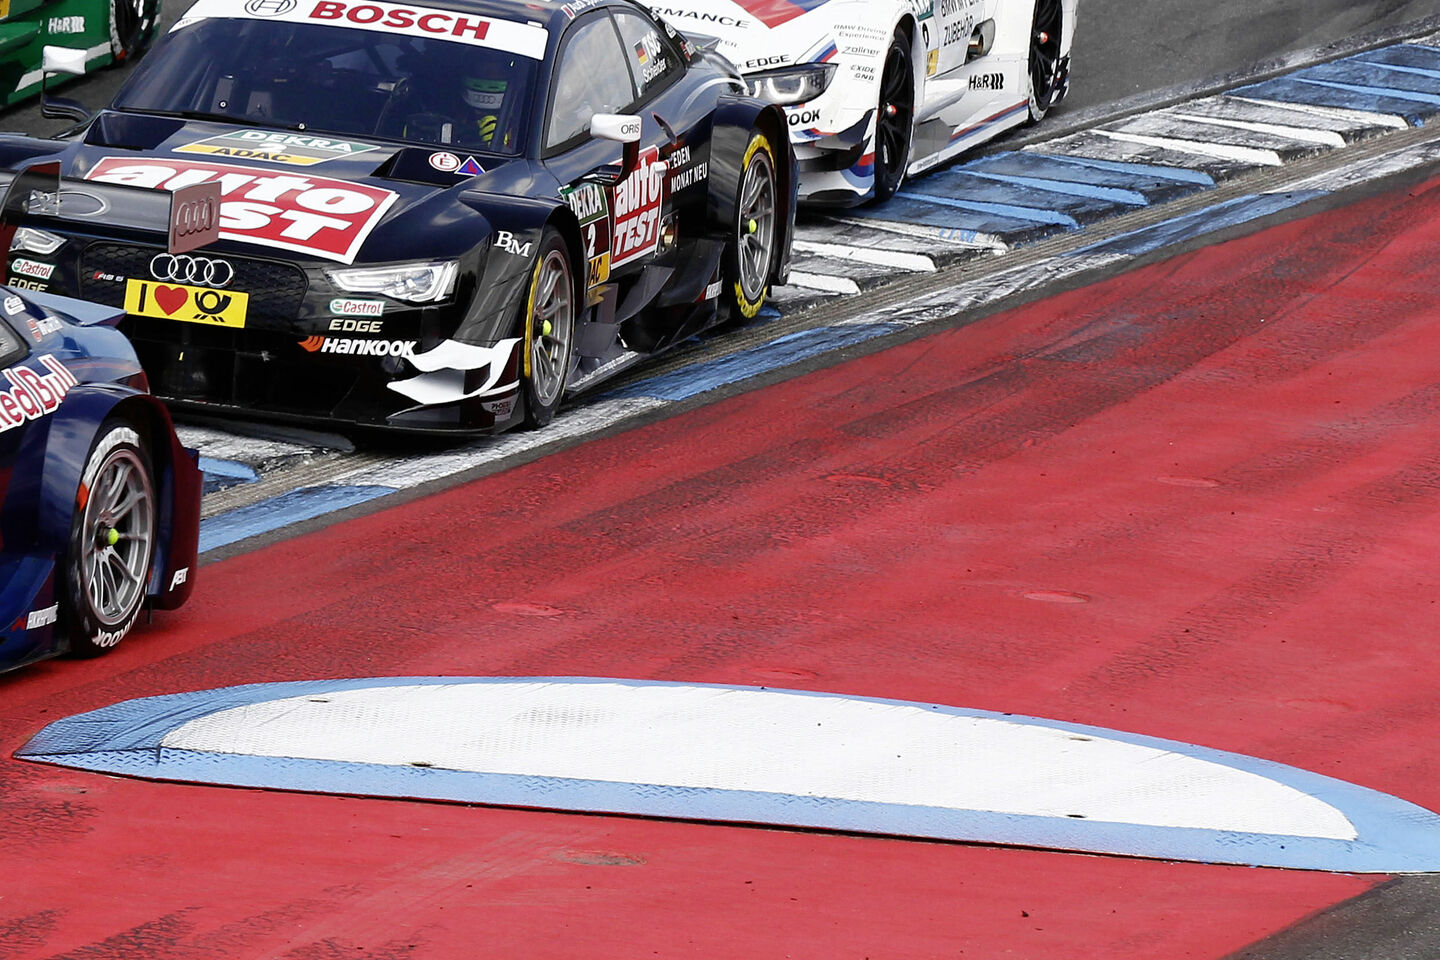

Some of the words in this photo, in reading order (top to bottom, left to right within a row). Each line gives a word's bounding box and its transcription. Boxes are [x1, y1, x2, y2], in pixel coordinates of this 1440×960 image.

[308, 0, 491, 41] BOSCH
[833, 23, 856, 31] BMW
[857, 24, 887, 36] Driving
[838, 31, 886, 42] Experience
[643, 56, 668, 83] Scheider
[746, 53, 792, 69] EDGE
[243, 130, 353, 153] DEKRA
[620, 123, 640, 135] ORIS
[213, 147, 293, 162] ADAC
[101, 163, 375, 215] auto
[615, 156, 661, 218] auto
[671, 169, 693, 194] MONAT
[693, 161, 708, 183] NEU
[569, 185, 603, 219] DEKRA
[219, 201, 353, 242] ST
[614, 206, 659, 257] TEST
[586, 223, 597, 258] 2
[20, 261, 52, 279] Castrol
[8, 277, 49, 292] EDGE
[342, 299, 383, 316] Castrol
[329, 319, 384, 333] EDGE
[11, 353, 79, 415] Bull
